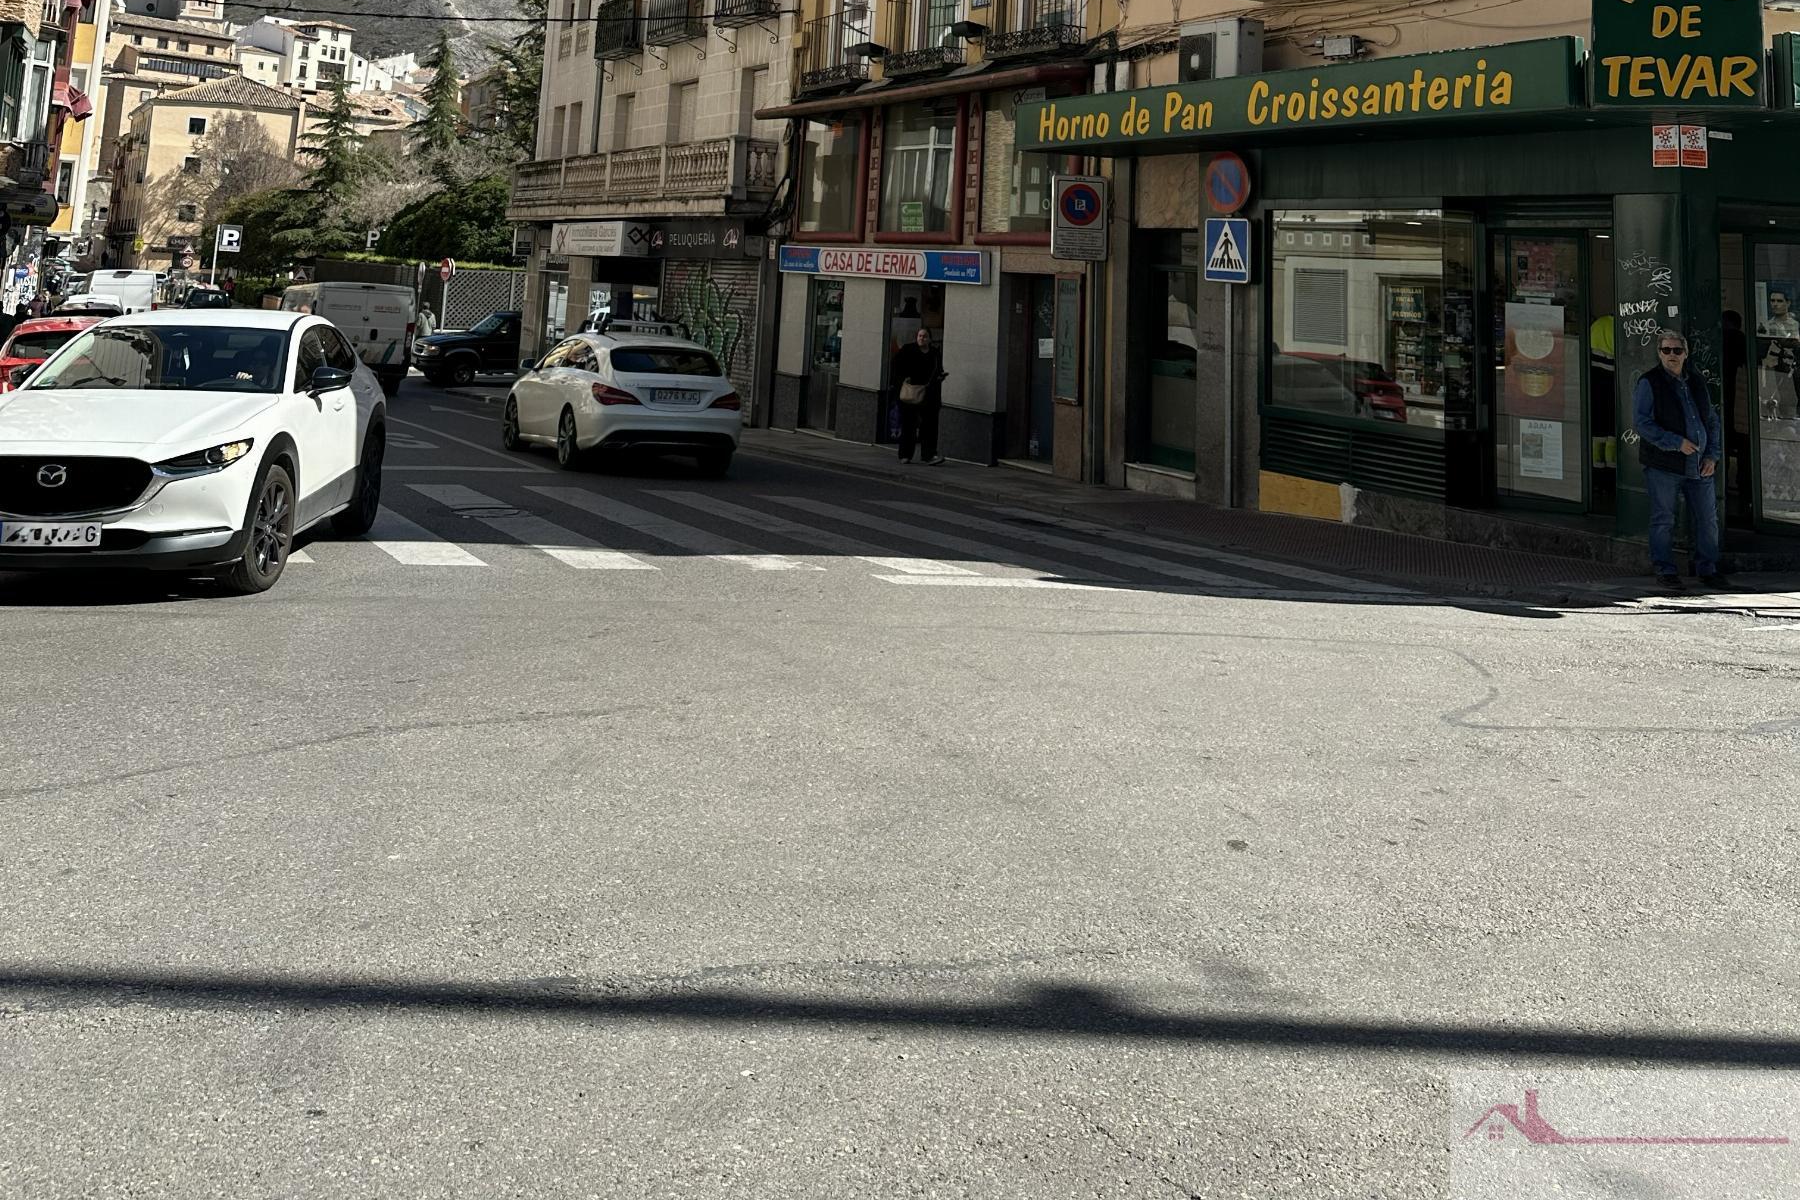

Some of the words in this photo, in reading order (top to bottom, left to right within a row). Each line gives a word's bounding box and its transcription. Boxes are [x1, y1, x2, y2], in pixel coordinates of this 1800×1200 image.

[1652, 6, 1700, 38] DE
[1602, 54, 1758, 99] TEVAR
[1039, 103, 1110, 143] Horno
[1120, 95, 1151, 137] de
[1163, 90, 1213, 133] Pan
[1247, 58, 1514, 127] Croissanteria
[222, 229, 240, 246] P
[669, 231, 715, 248] PELUQUERÍA
[824, 252, 854, 272] CASA
[857, 253, 873, 273] DE
[875, 254, 918, 275] LERMA
